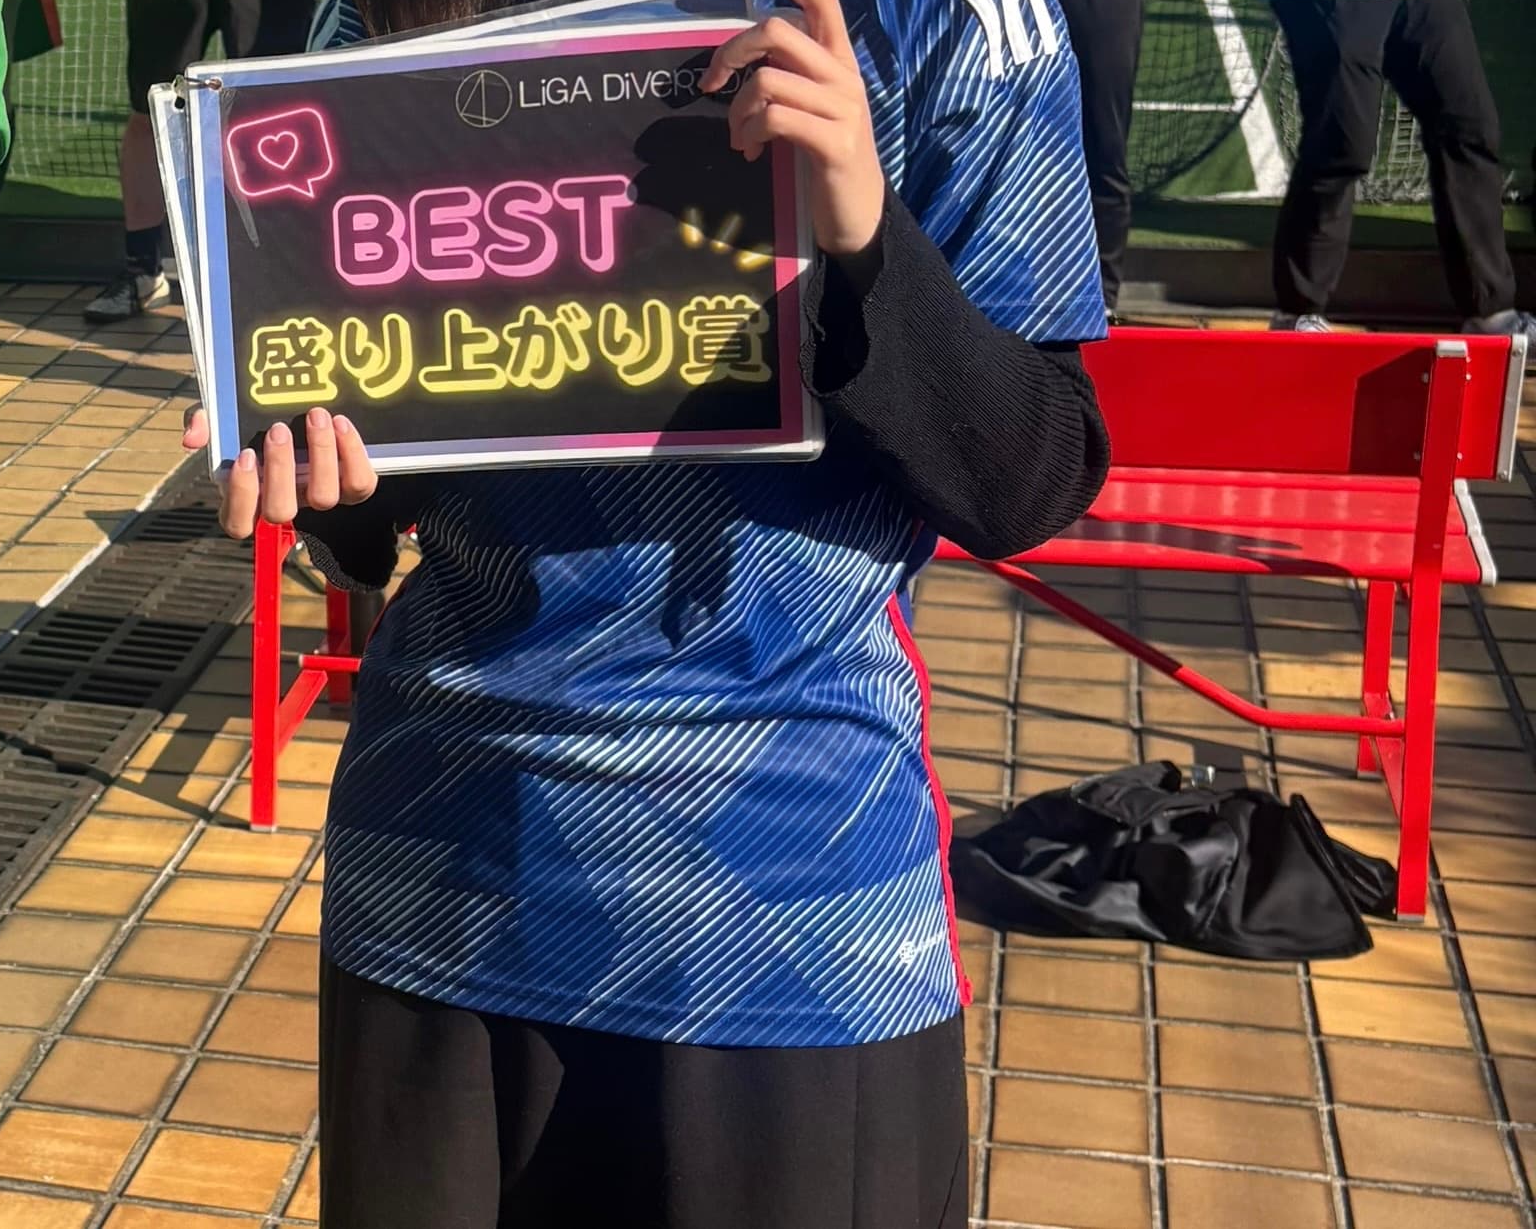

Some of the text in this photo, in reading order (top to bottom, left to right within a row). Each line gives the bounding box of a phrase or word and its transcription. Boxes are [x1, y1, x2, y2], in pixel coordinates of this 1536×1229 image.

[333, 175, 637, 286] BEST
[249, 293, 772, 405] 盛り上がり賞
